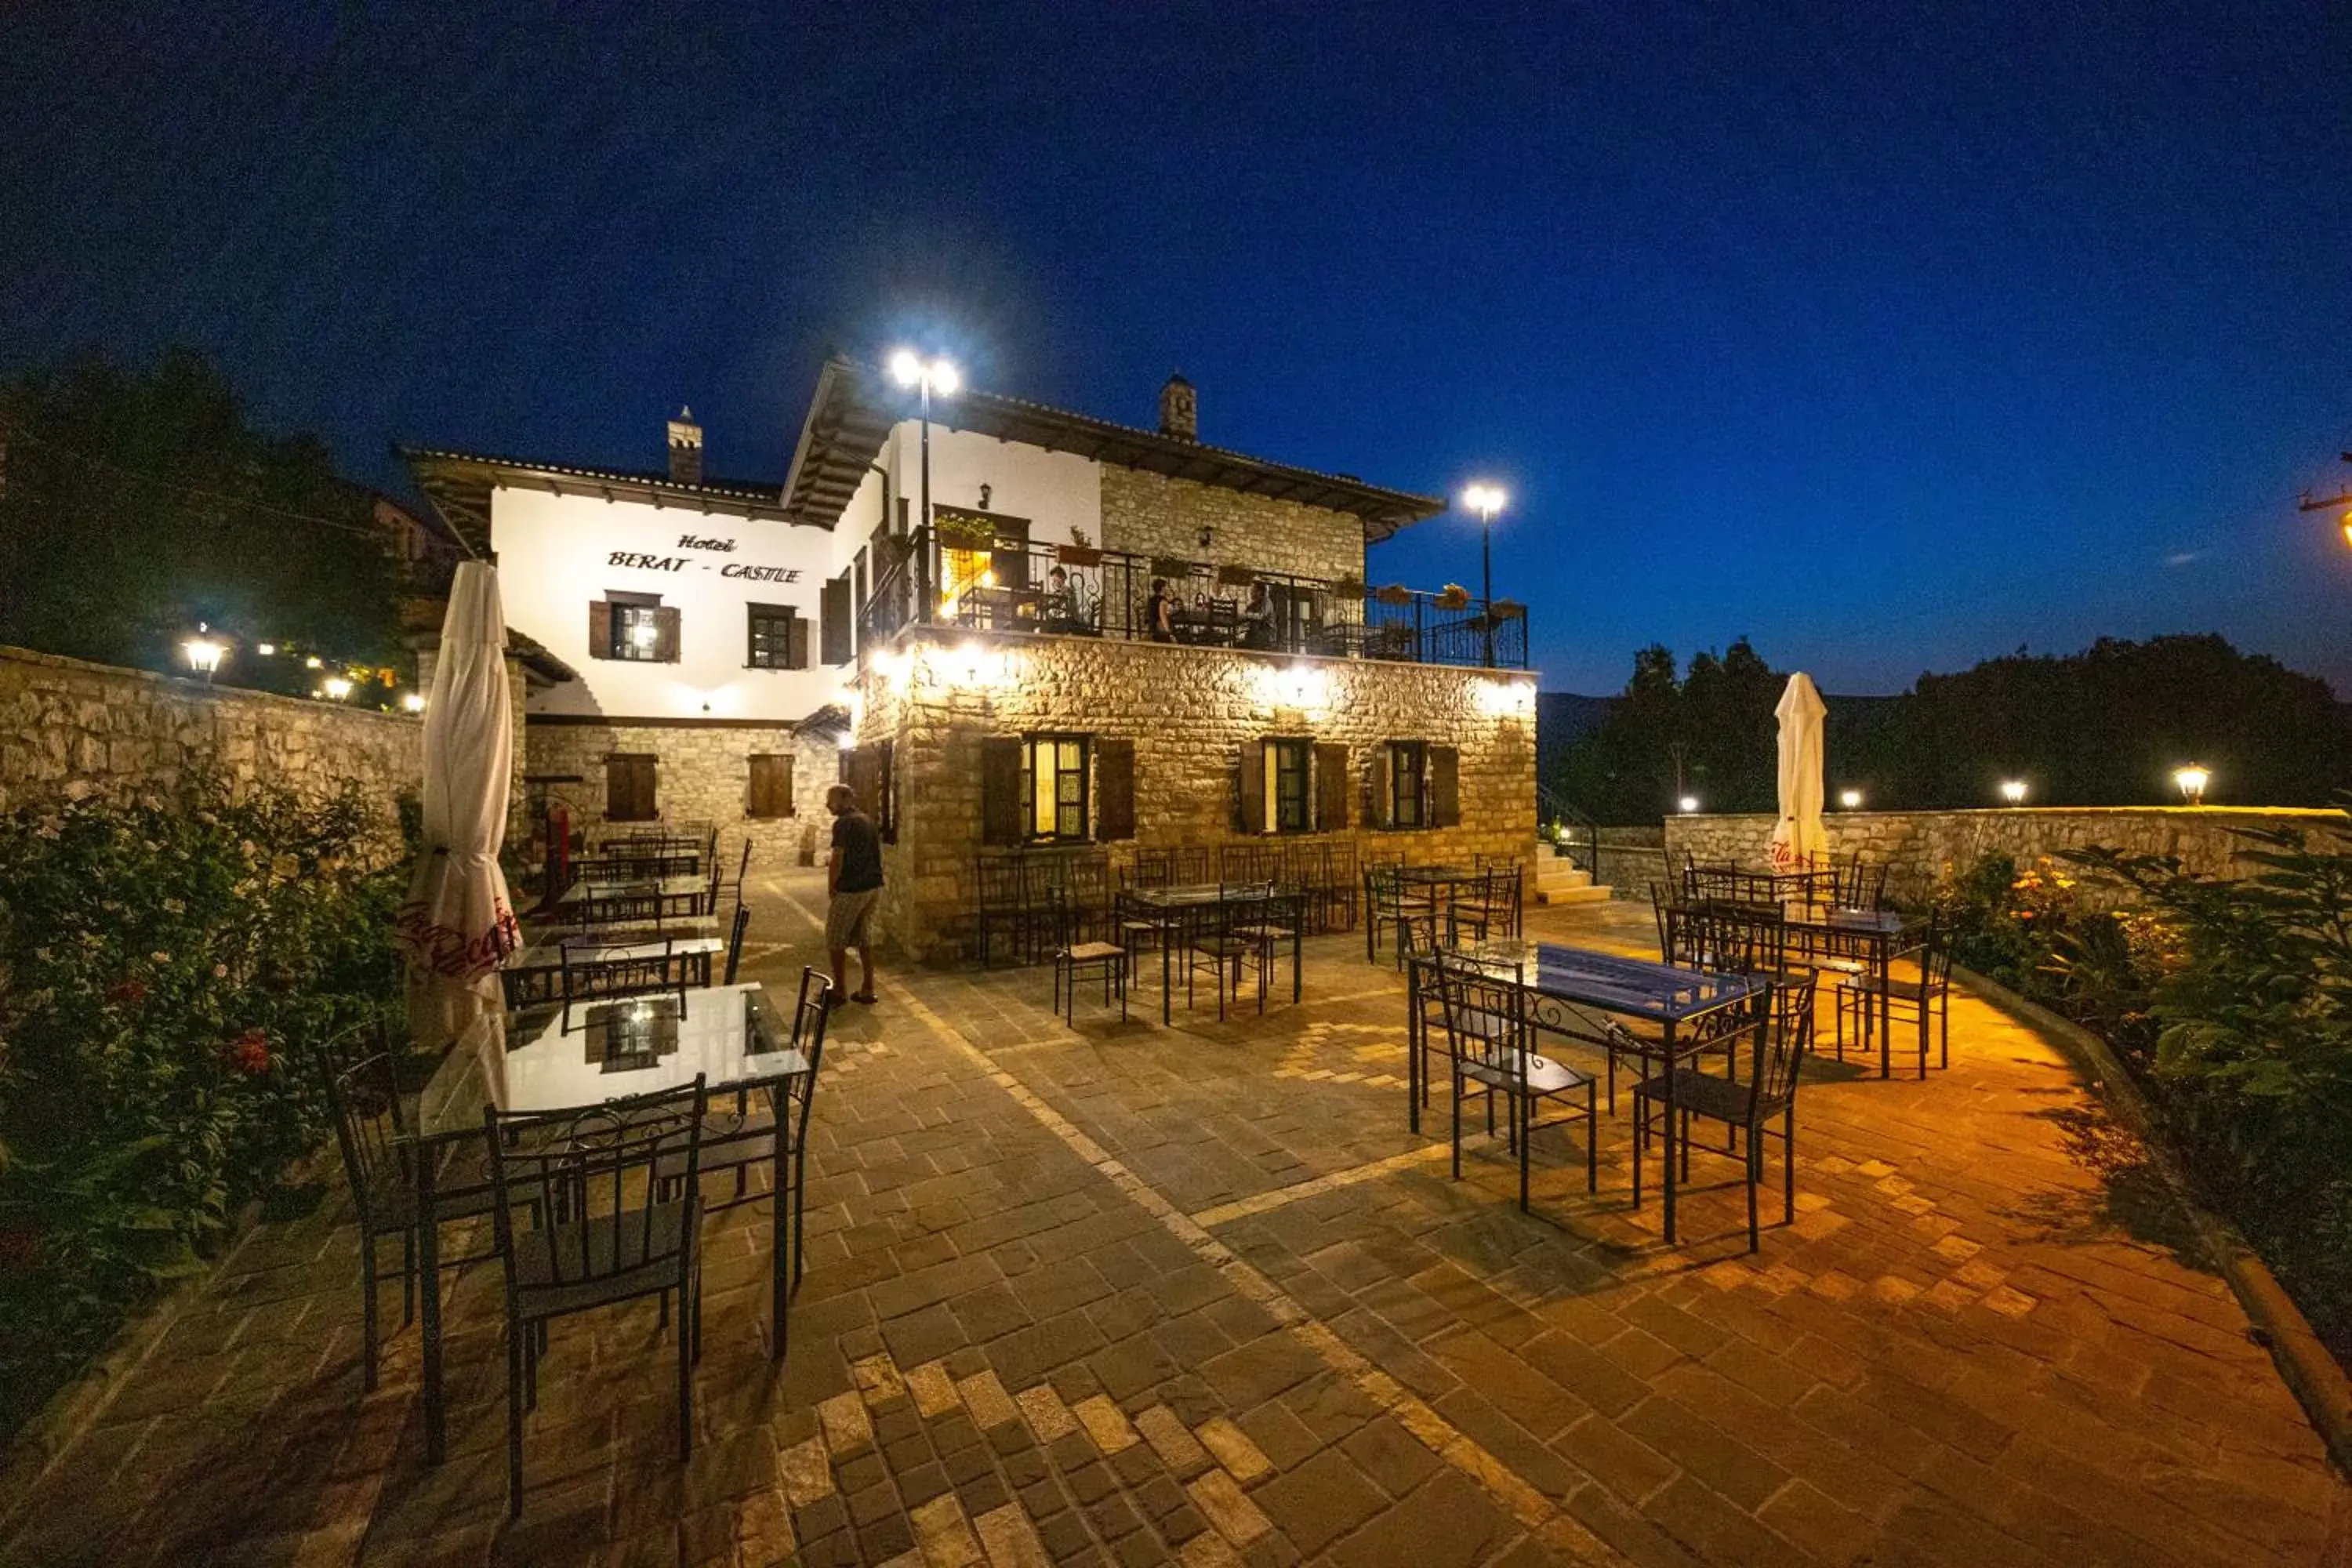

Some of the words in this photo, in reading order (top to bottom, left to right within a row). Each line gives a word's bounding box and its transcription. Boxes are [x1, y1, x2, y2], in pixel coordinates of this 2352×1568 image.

[677, 535, 738, 553] Hotel
[608, 551, 694, 572] BERAT
[720, 564, 804, 584] CASTLE
